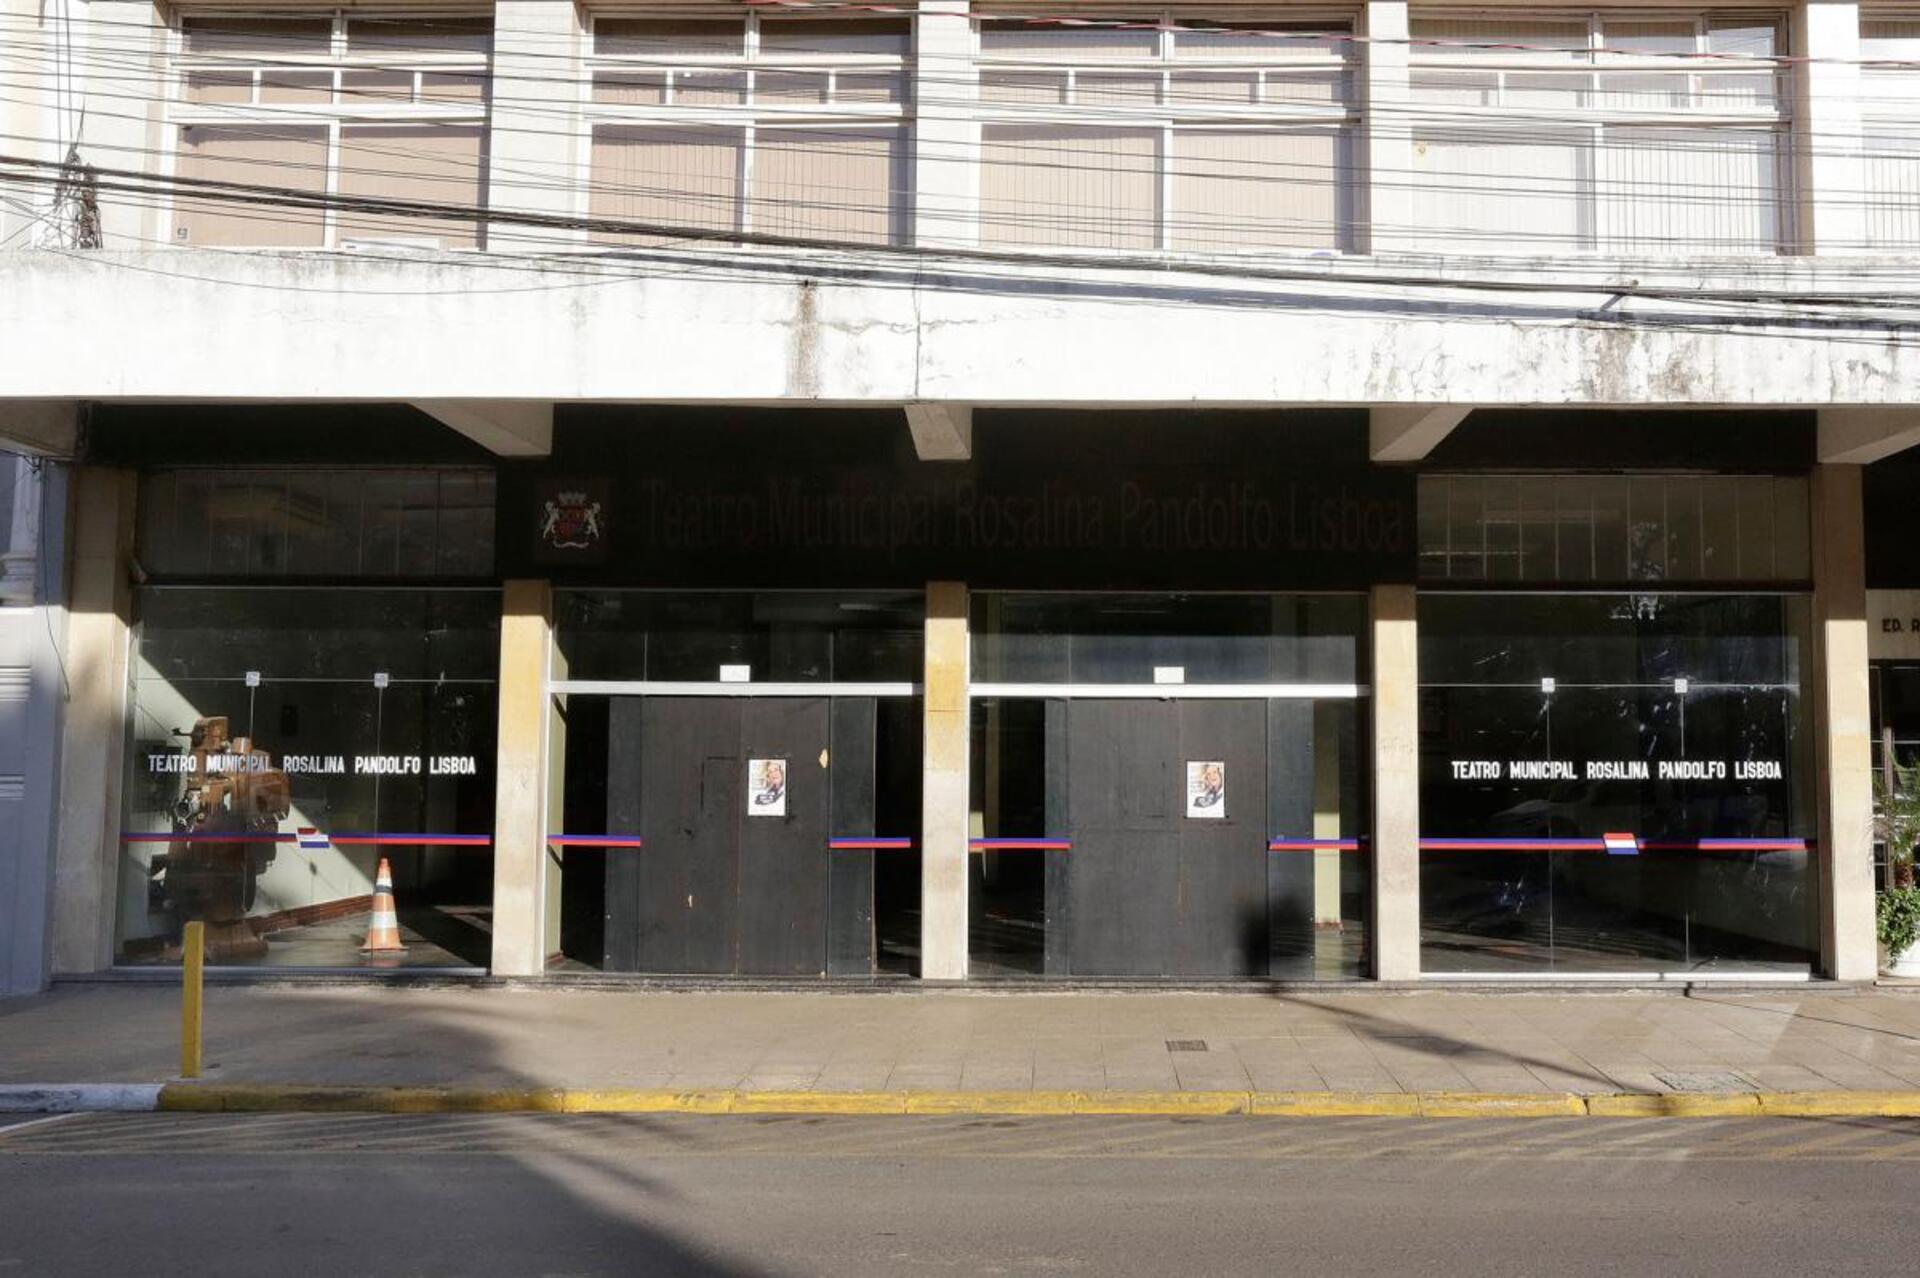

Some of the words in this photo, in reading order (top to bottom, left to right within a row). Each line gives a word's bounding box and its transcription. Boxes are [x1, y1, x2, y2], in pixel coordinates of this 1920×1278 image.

[640, 477, 756, 549] Teatro
[767, 474, 940, 563] Municipal
[956, 479, 1103, 549] Rosalina
[1121, 479, 1274, 549] Pandolfo
[1289, 479, 1404, 551] Lisboa
[1882, 618, 1904, 632] ED.
[148, 755, 197, 772] TEATRO
[206, 755, 272, 772] MUNICIPAL
[283, 755, 345, 773] ROSALINA
[355, 756, 421, 774] PANDOLFO
[430, 756, 476, 775] LISBOA
[1451, 761, 1500, 779] TEATRO
[1510, 761, 1577, 779] MUNICIPAL
[1587, 761, 1649, 779] ROSALINA
[1659, 761, 1726, 779] PANDOLFO
[1735, 761, 1782, 779] LISBOA
